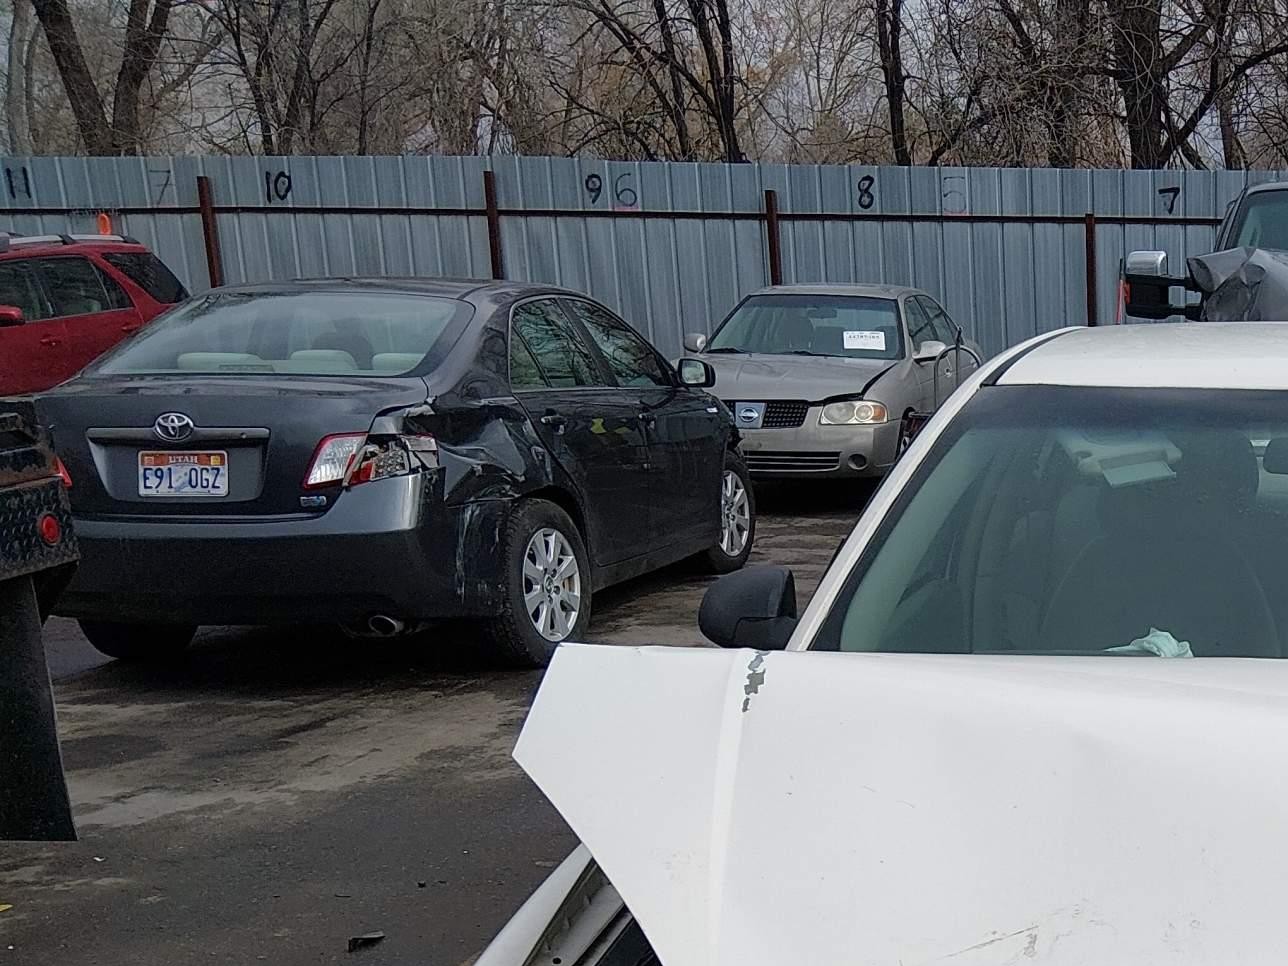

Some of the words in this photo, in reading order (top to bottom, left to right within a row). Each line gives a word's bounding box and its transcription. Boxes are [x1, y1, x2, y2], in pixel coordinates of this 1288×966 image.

[265, 170, 292, 204] 10
[858, 174, 874, 209] 8
[1157, 186, 1180, 215] 7
[168, 455, 198, 464] UTAH
[143, 467, 175, 489] E91
